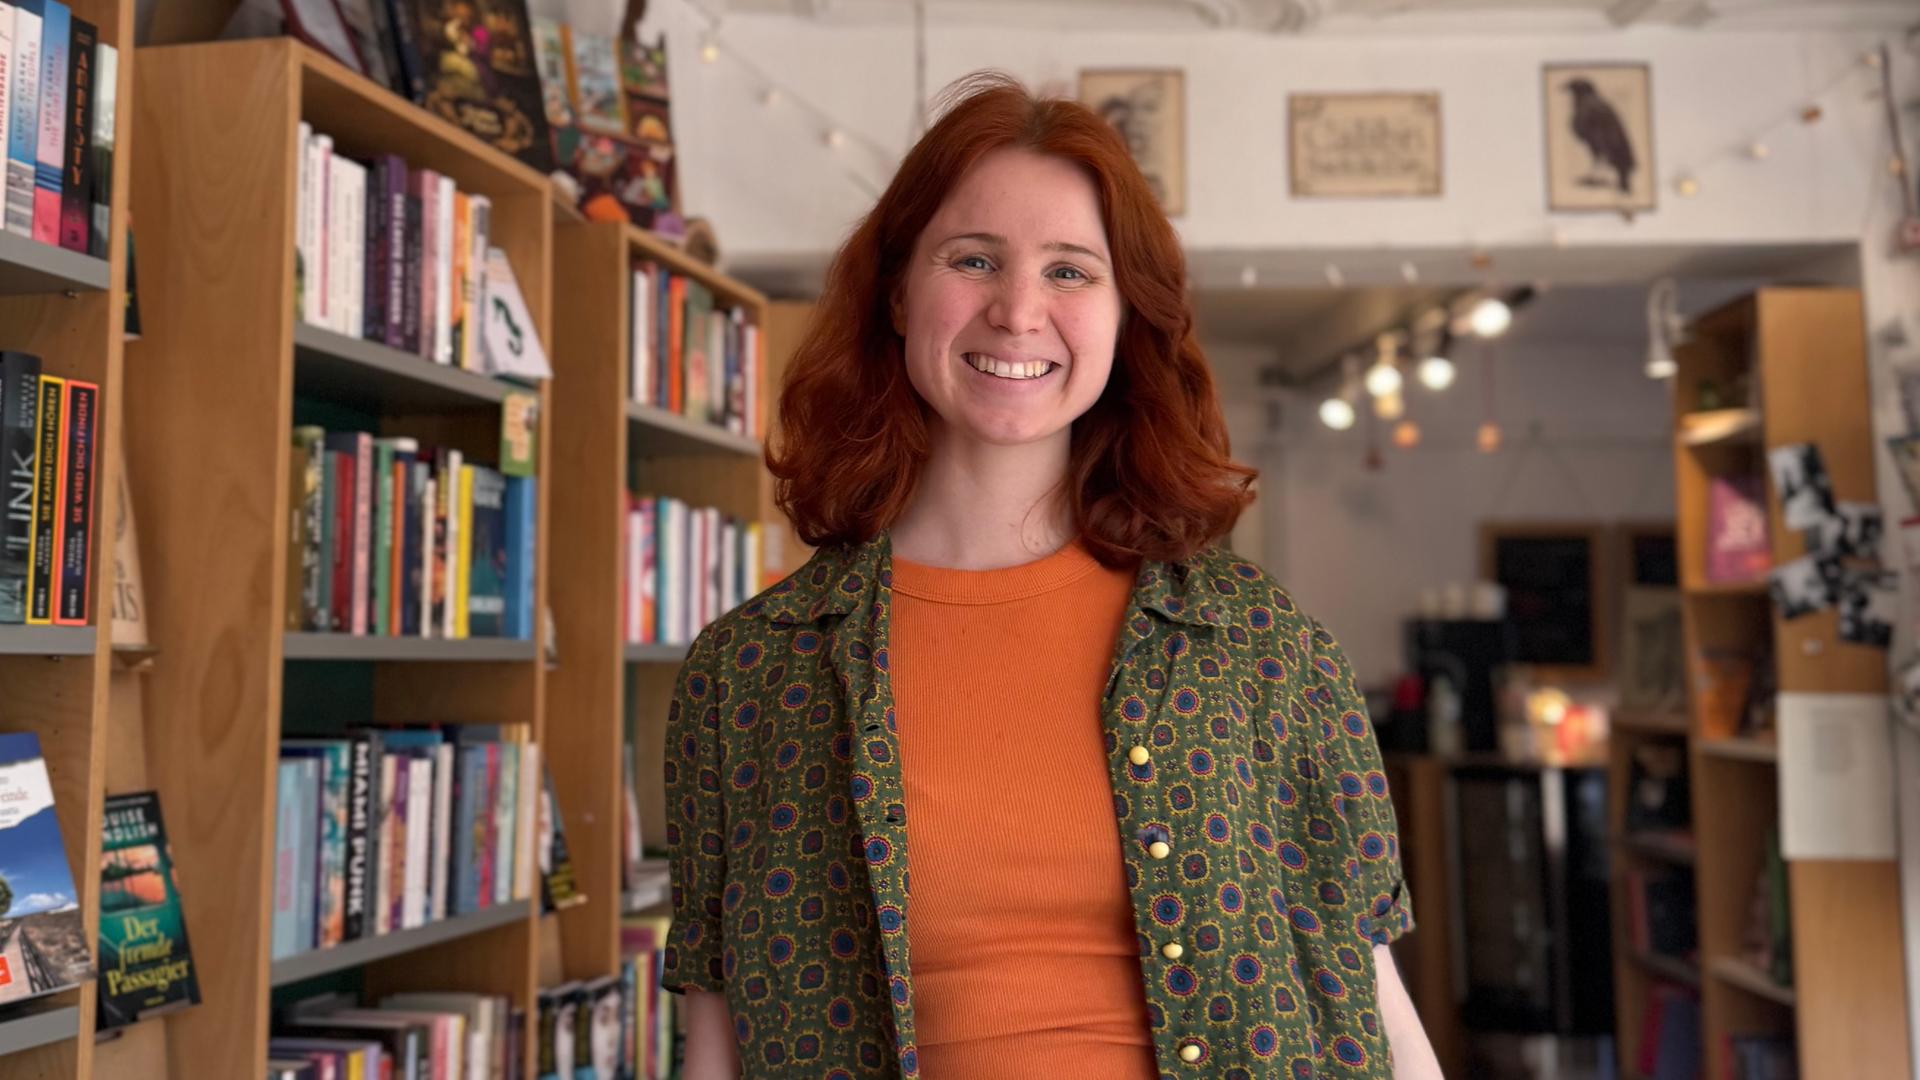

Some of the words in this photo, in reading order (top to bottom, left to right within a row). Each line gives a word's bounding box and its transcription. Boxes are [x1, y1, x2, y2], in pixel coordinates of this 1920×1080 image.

[19, 53, 27, 101] CLARKE
[46, 55, 54, 98] CLARKE
[16, 108, 24, 140] LUCY
[45, 387, 56, 431] HÖREN
[77, 392, 88, 436] FINDEN
[44, 432, 54, 464] DICH
[75, 439, 86, 469] DICH
[43, 466, 52, 500] KANN
[73, 471, 85, 504] WIRD
[42, 503, 51, 521] SIE
[72, 507, 83, 524] SIE
[353, 742, 369, 830] MIAMI
[102, 807, 145, 828] OUISE
[348, 837, 366, 914] PUNK
[123, 915, 160, 942] Der
[118, 930, 174, 973] fremde
[106, 960, 189, 998] Passagier
